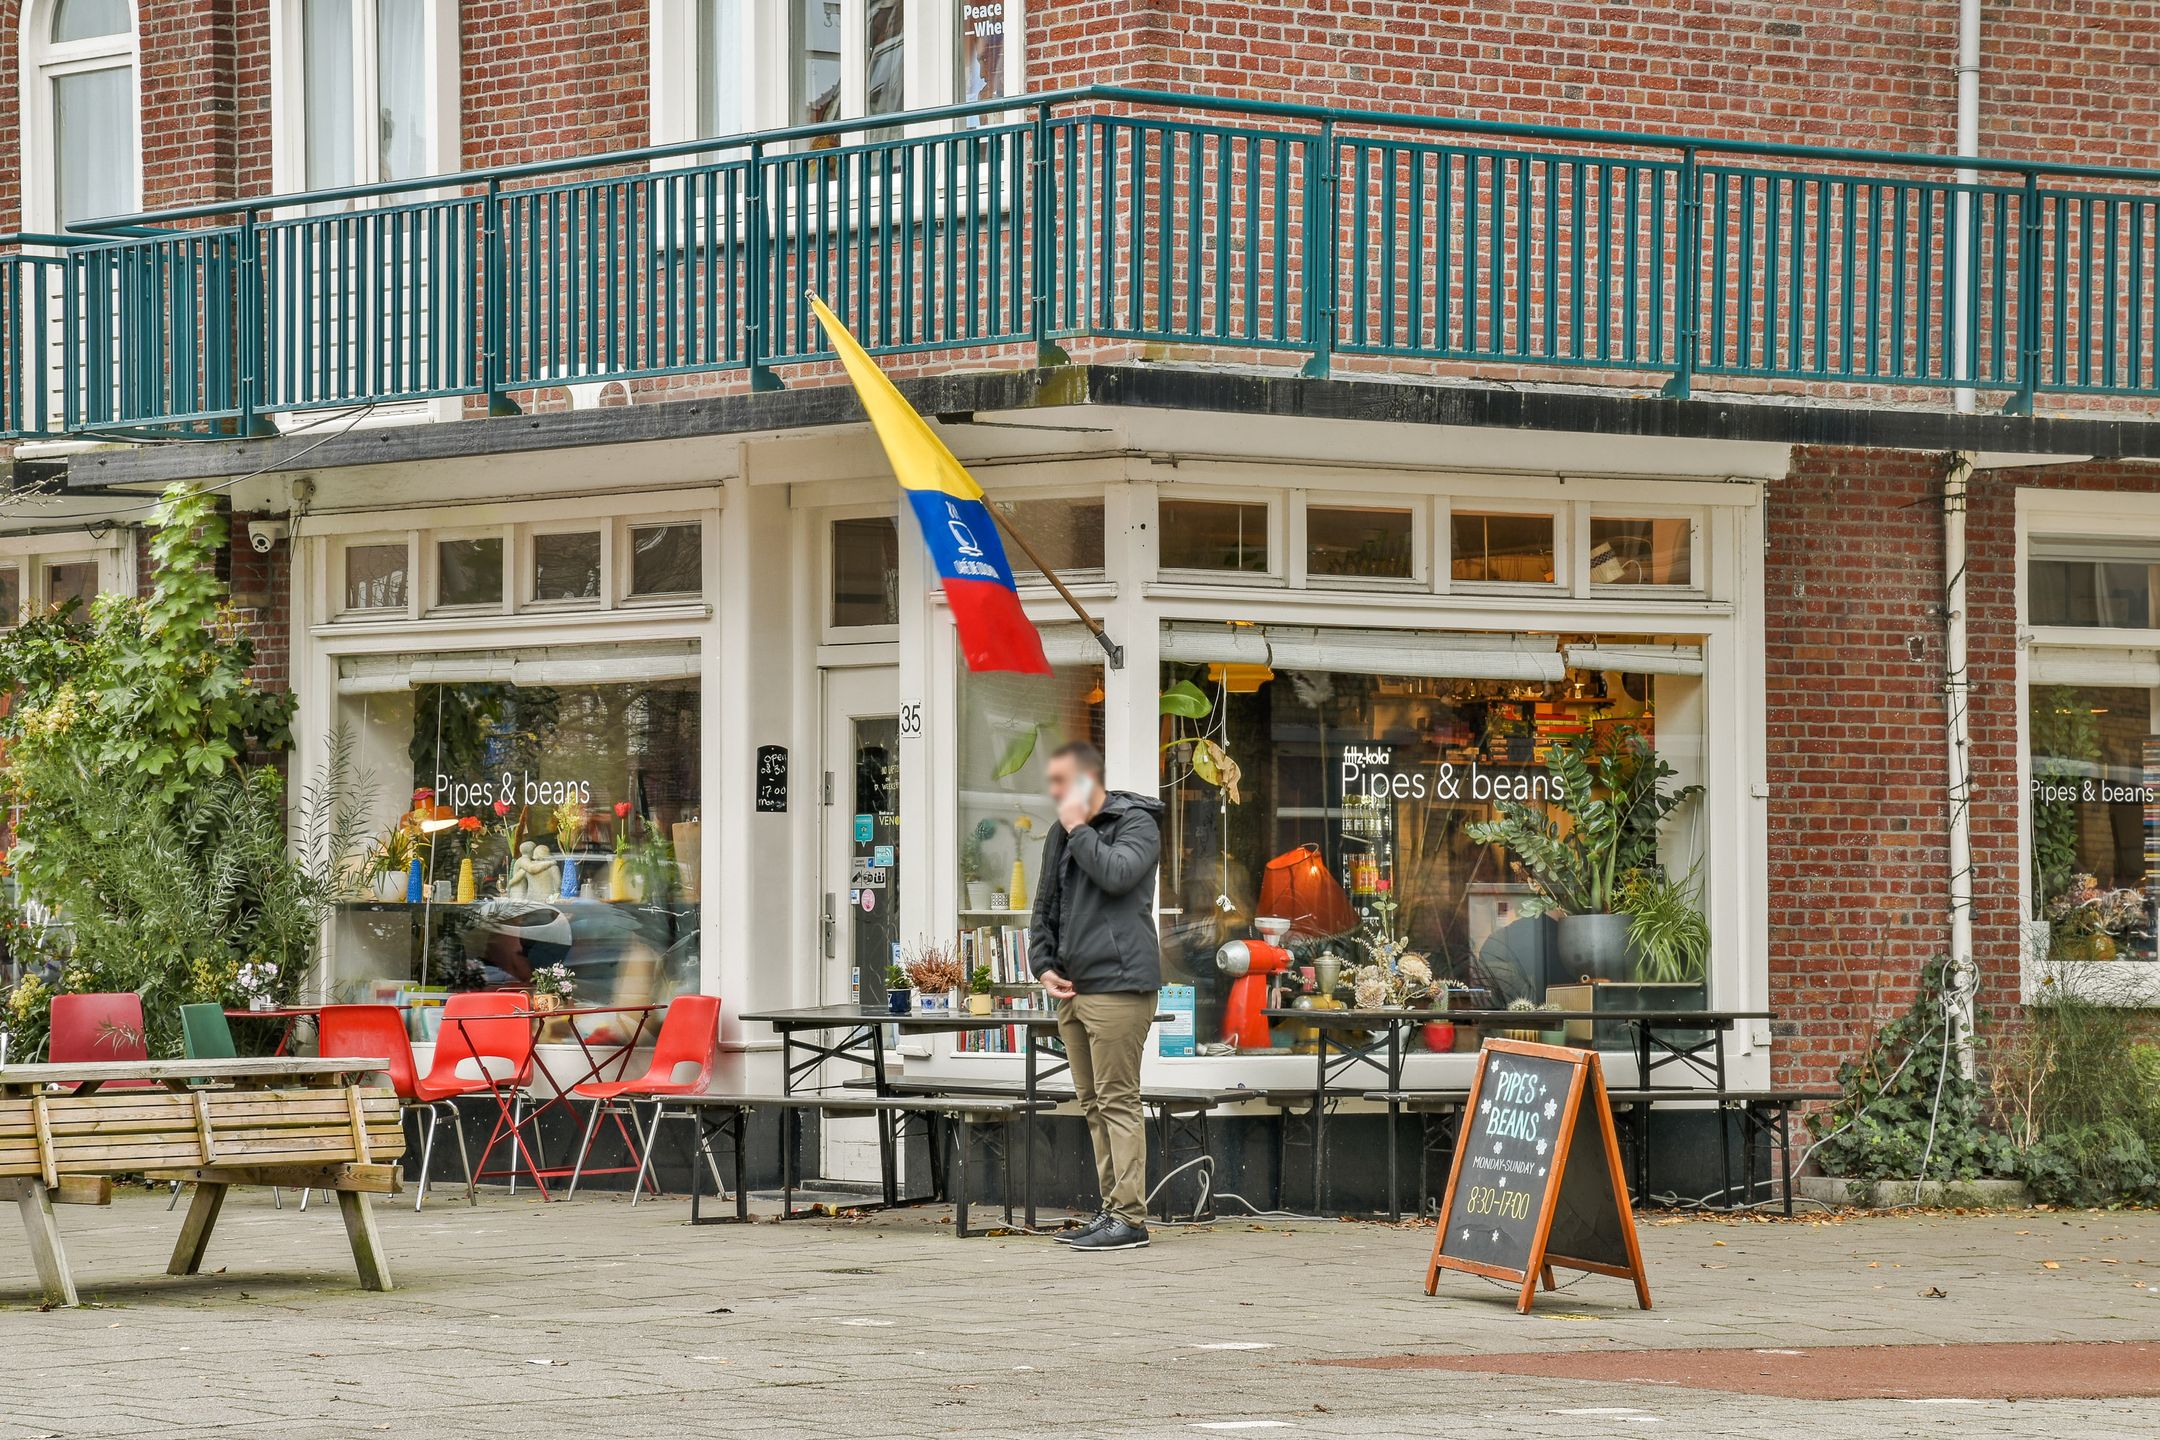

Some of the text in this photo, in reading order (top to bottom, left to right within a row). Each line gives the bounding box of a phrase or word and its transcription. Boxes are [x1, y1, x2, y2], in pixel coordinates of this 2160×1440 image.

[963, 3, 1002, 20] Peace
[902, 705, 921, 733] 35
[436, 770, 590, 816] Pipes & beans
[1342, 761, 1565, 808] Pipes & beans
[2030, 779, 2155, 807] Pipes & beans
[1495, 1071, 1538, 1104] PIPES
[1486, 1106, 1540, 1142] BEANS
[1472, 1155, 1535, 1175] MONDAY-SUNDAY
